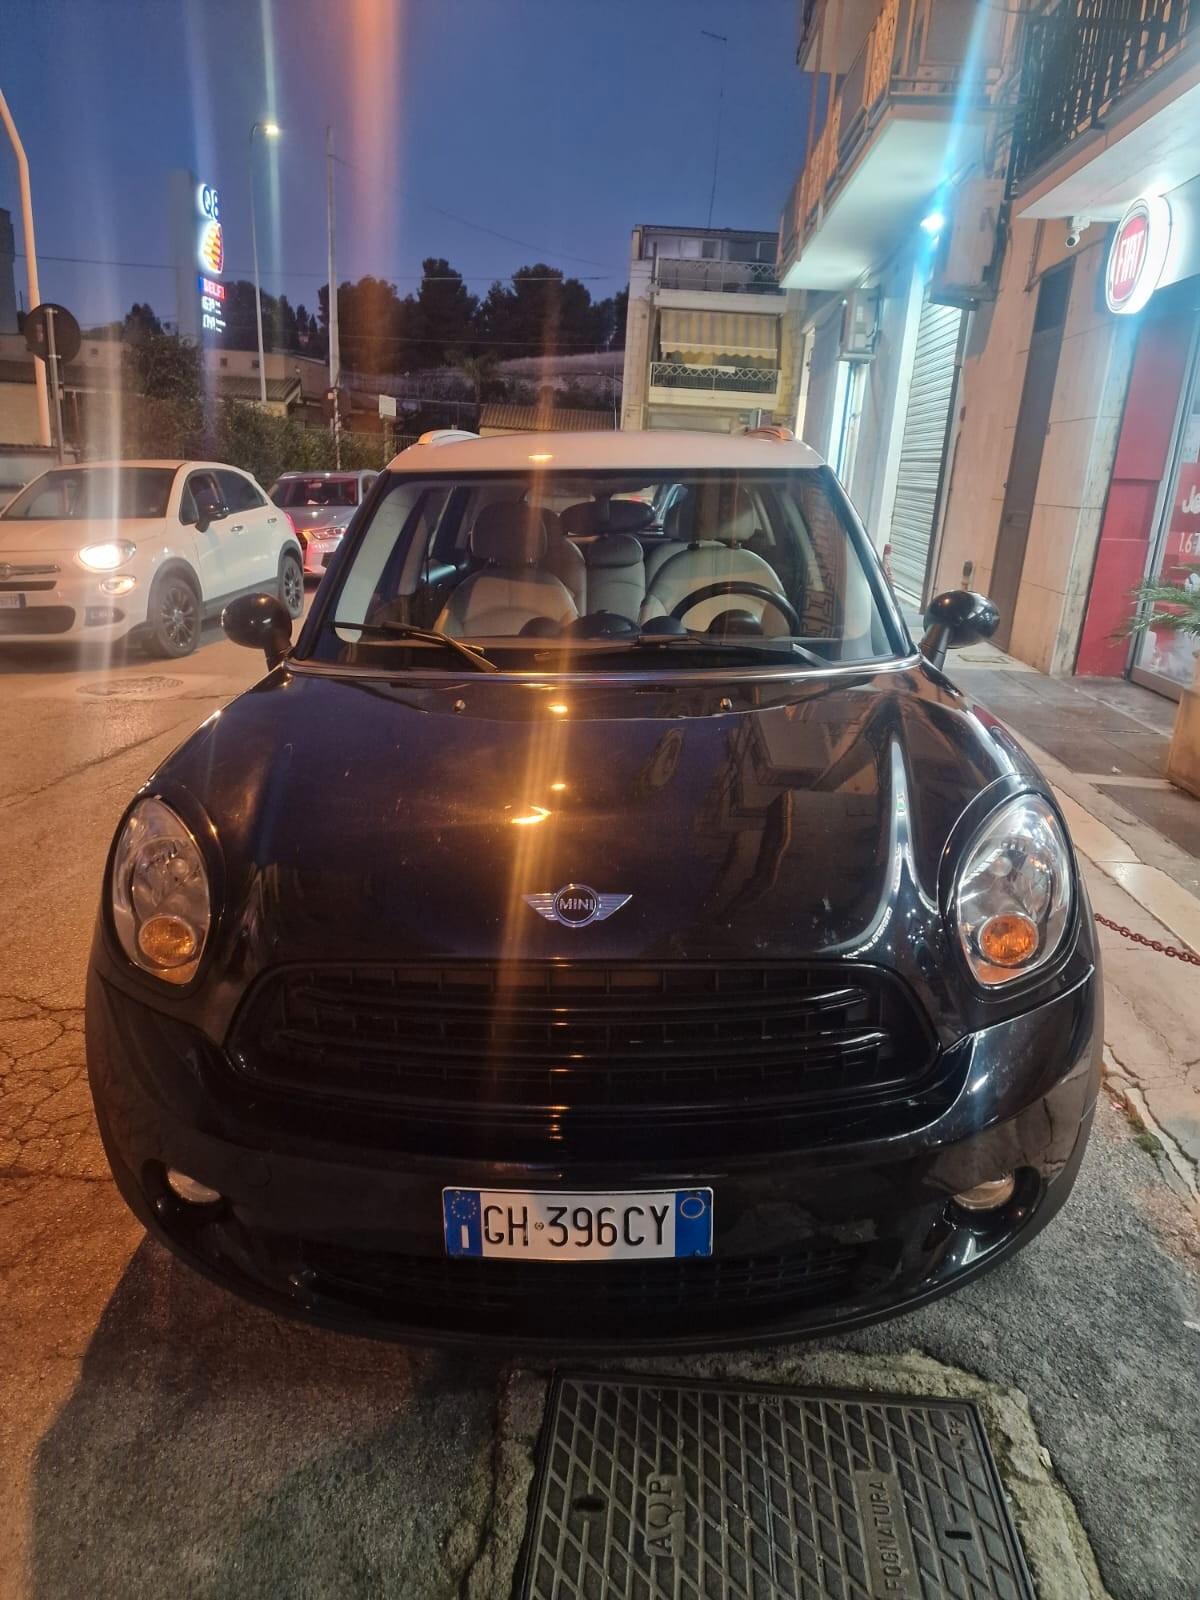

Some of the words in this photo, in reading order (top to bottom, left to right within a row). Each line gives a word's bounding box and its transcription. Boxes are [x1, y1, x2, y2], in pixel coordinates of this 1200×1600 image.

[202, 185, 220, 220] Q8
[1113, 230, 1145, 286] FIAT
[559, 898, 595, 911] MINI
[483, 1204, 529, 1247] GH
[546, 1204, 670, 1248] 396CY
[647, 1480, 683, 1554] AQP
[868, 1481, 906, 1592] FOGNATURA
